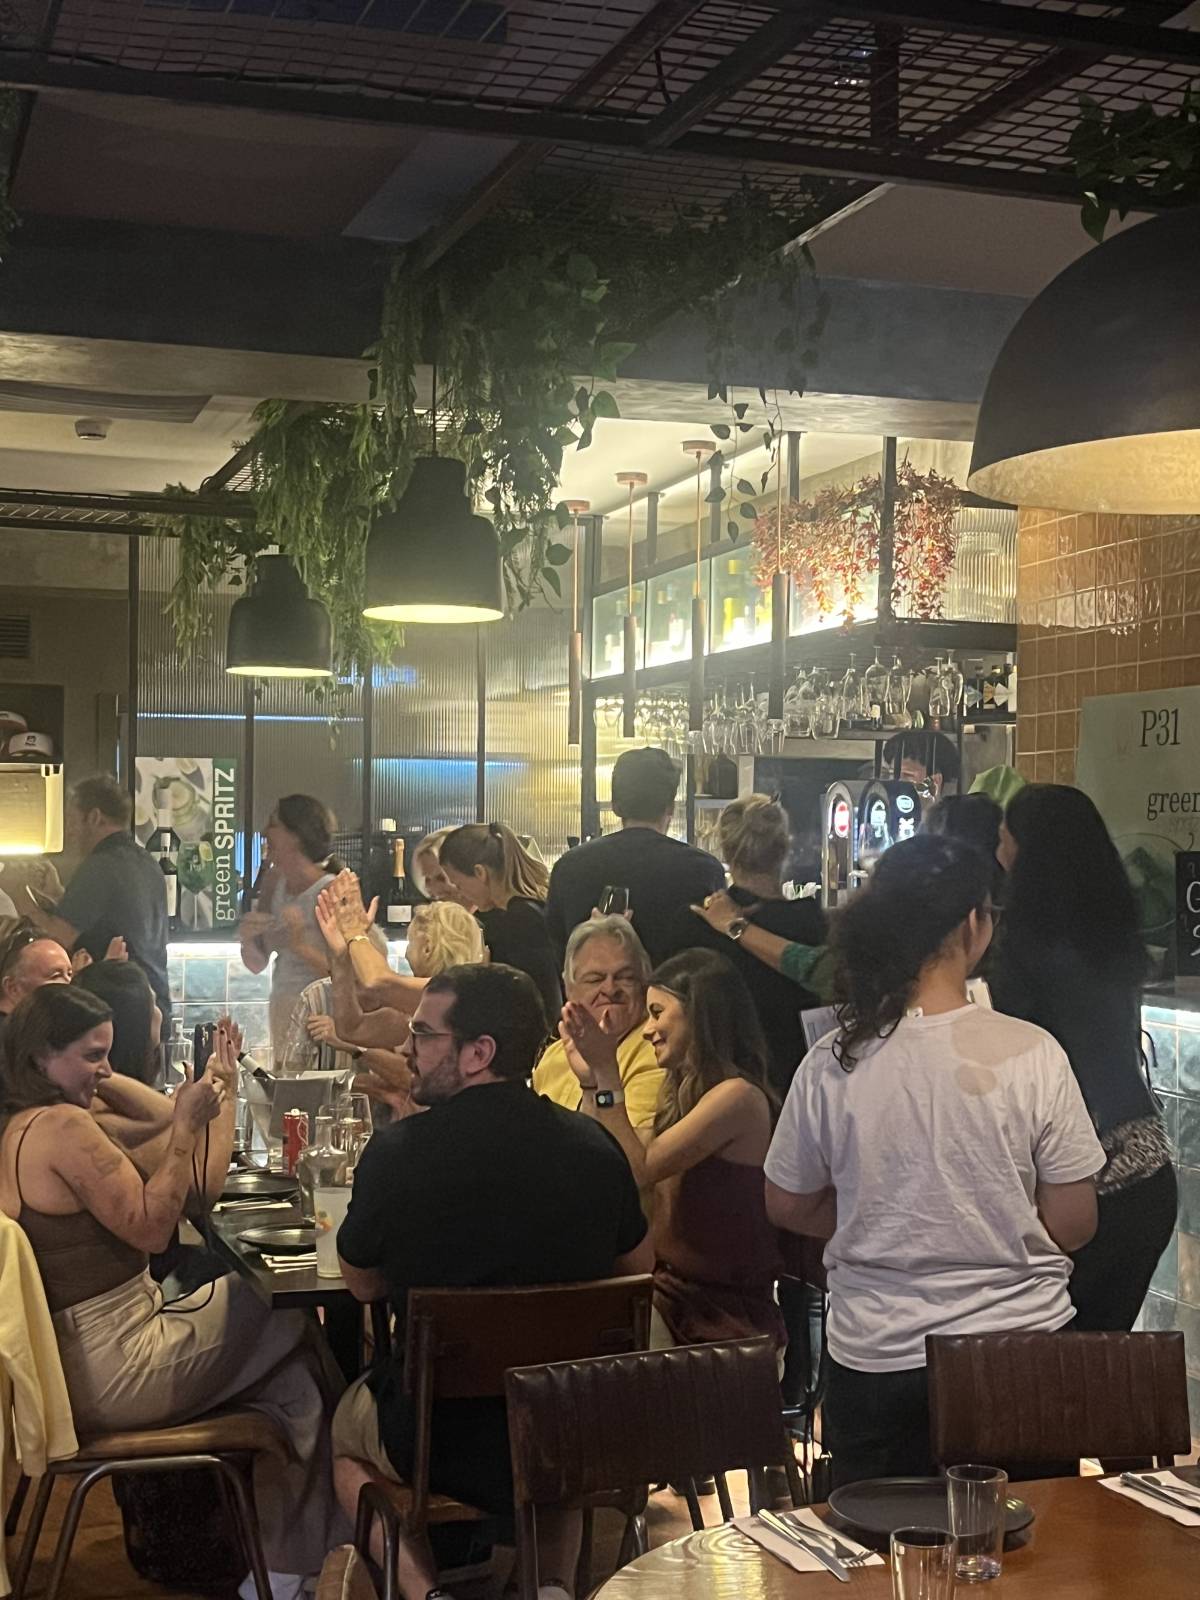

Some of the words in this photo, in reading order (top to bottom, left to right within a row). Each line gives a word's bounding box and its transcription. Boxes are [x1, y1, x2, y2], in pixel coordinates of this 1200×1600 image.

[1140, 708, 1181, 747] P31
[214, 768, 235, 849] SPRITZ
[215, 853, 235, 921] green
